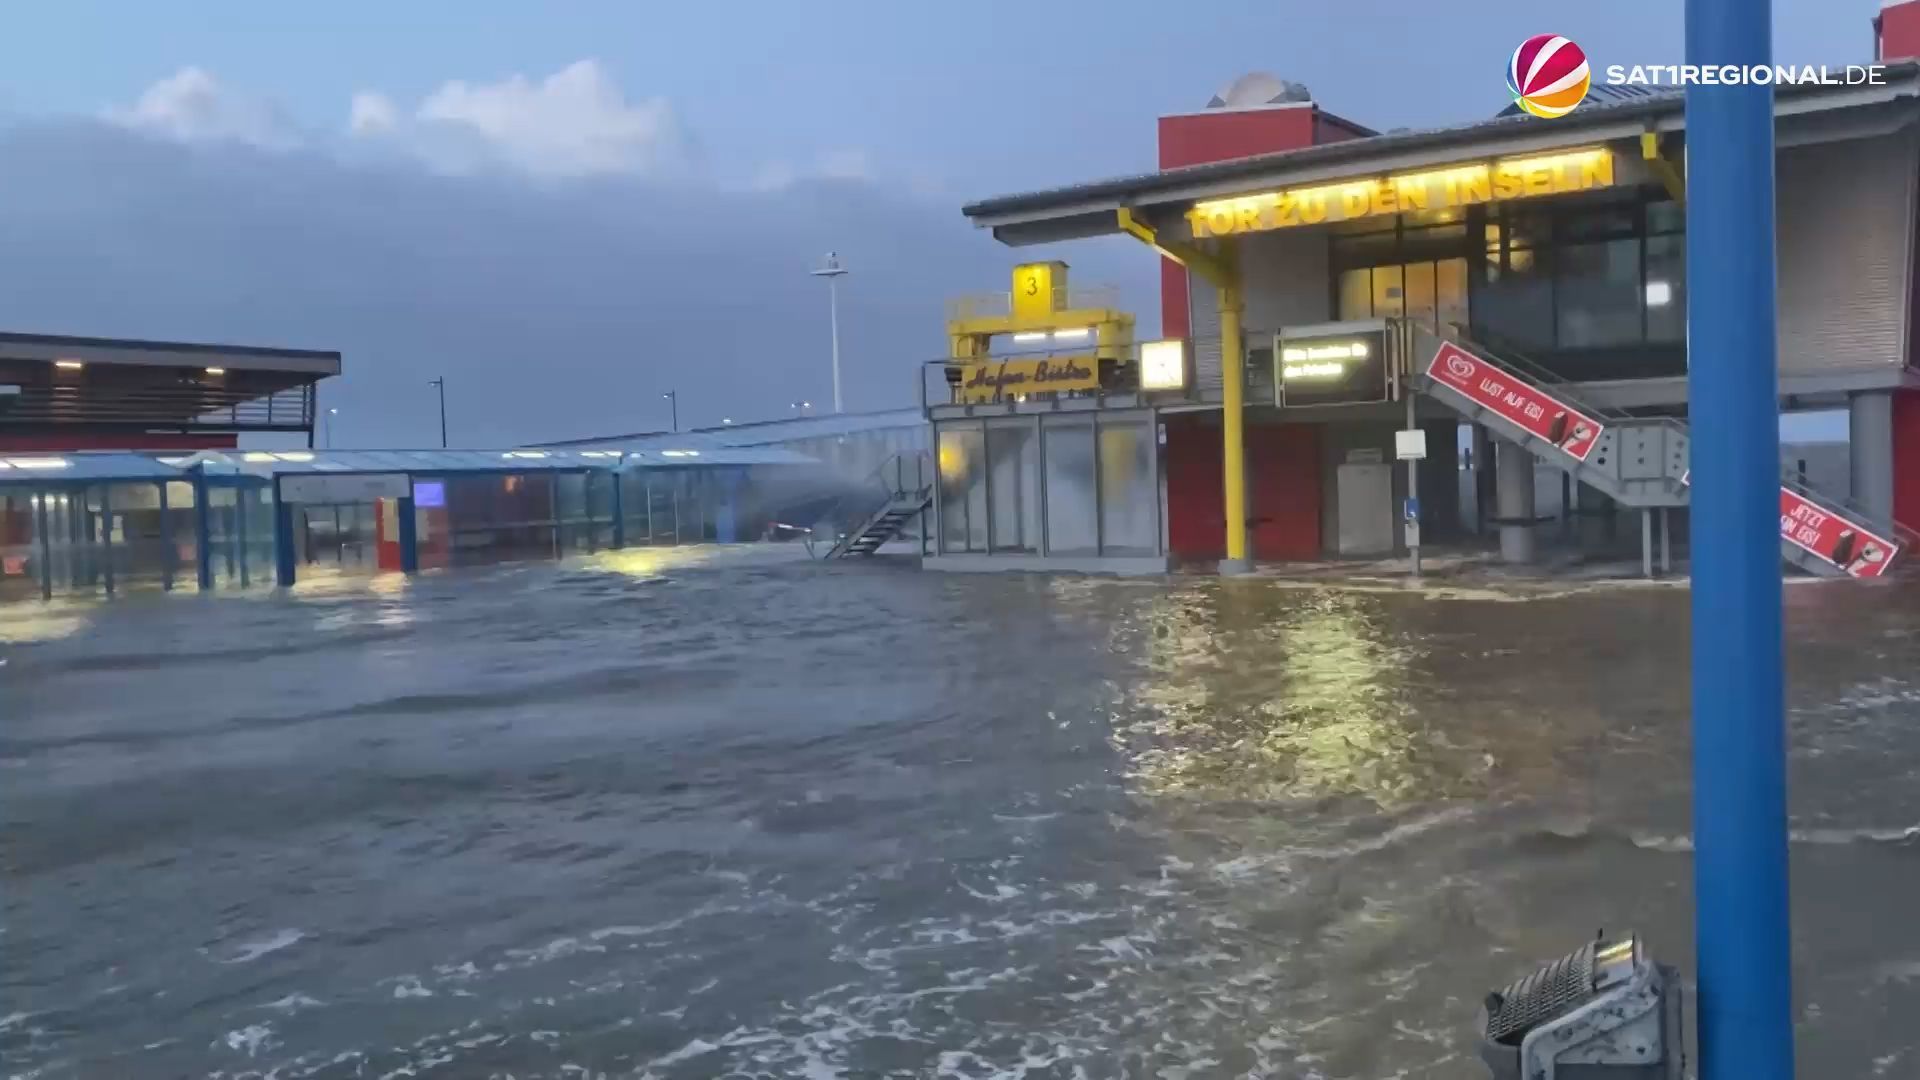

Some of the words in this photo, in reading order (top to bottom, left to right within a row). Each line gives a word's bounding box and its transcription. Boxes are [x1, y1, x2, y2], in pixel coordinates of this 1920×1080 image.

[1186, 208, 1262, 238] TOR
[1274, 193, 1327, 227] ZU
[1342, 179, 1426, 218] DEN
[1445, 149, 1614, 203] INSELN
[1026, 277, 1038, 296] 3
[966, 357, 1092, 398] Hafen-Bistro
[1479, 377, 1504, 398] LUST
[1503, 391, 1526, 408] AUF
[1524, 401, 1545, 422] EIS!
[1790, 504, 1827, 528] JETZT
[1796, 525, 1821, 548] EIS!
